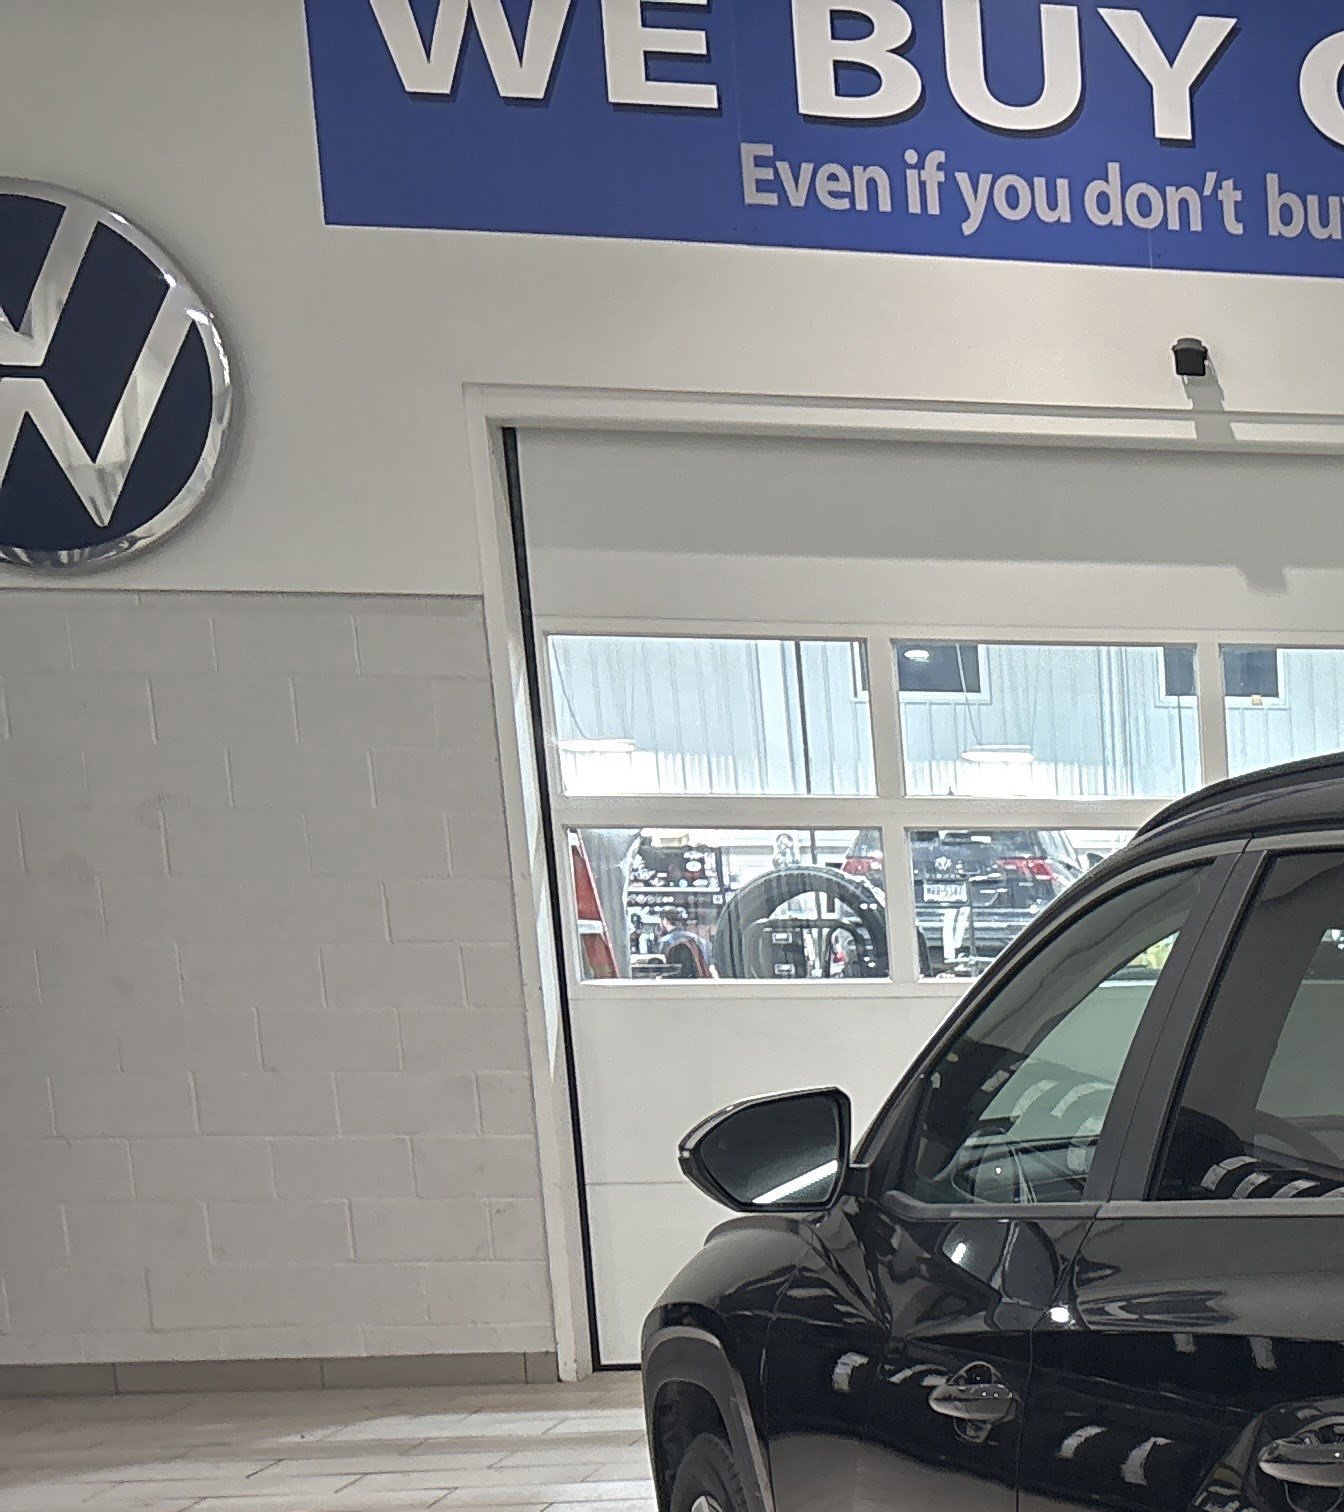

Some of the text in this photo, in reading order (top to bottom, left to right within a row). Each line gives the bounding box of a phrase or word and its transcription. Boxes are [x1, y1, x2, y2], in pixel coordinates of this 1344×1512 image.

[369, 0, 720, 110] WE
[793, 0, 1240, 142] BUY
[739, 141, 893, 214] Even
[903, 148, 946, 216] if
[954, 170, 1072, 237] you
